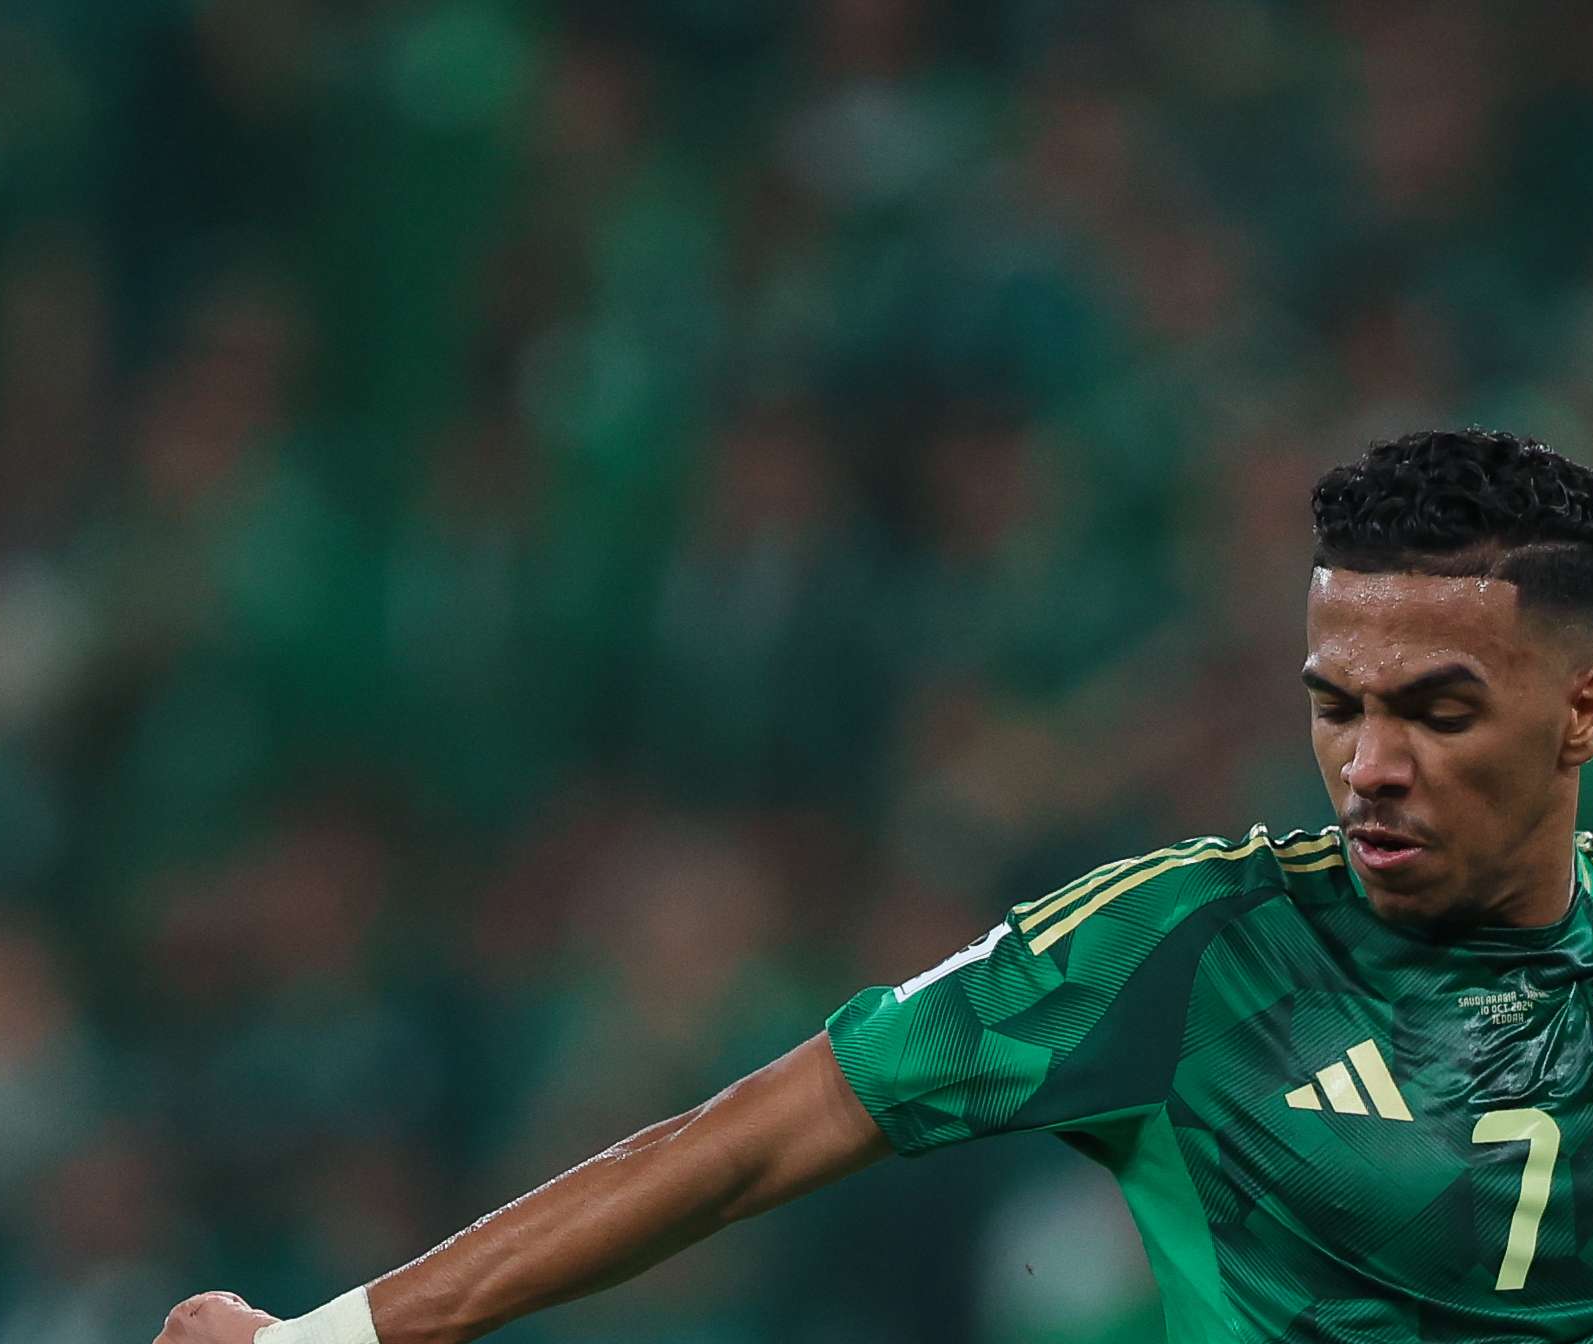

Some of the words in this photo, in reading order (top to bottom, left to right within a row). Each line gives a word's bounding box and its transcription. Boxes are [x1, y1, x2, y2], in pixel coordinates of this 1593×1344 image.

[1458, 995, 1484, 1008] SAUDI
[1485, 990, 1517, 1005] ARABIA
[1480, 1005, 1490, 1016] 10
[1510, 1000, 1534, 1012] 2024
[1472, 1103, 1561, 1291] 7
